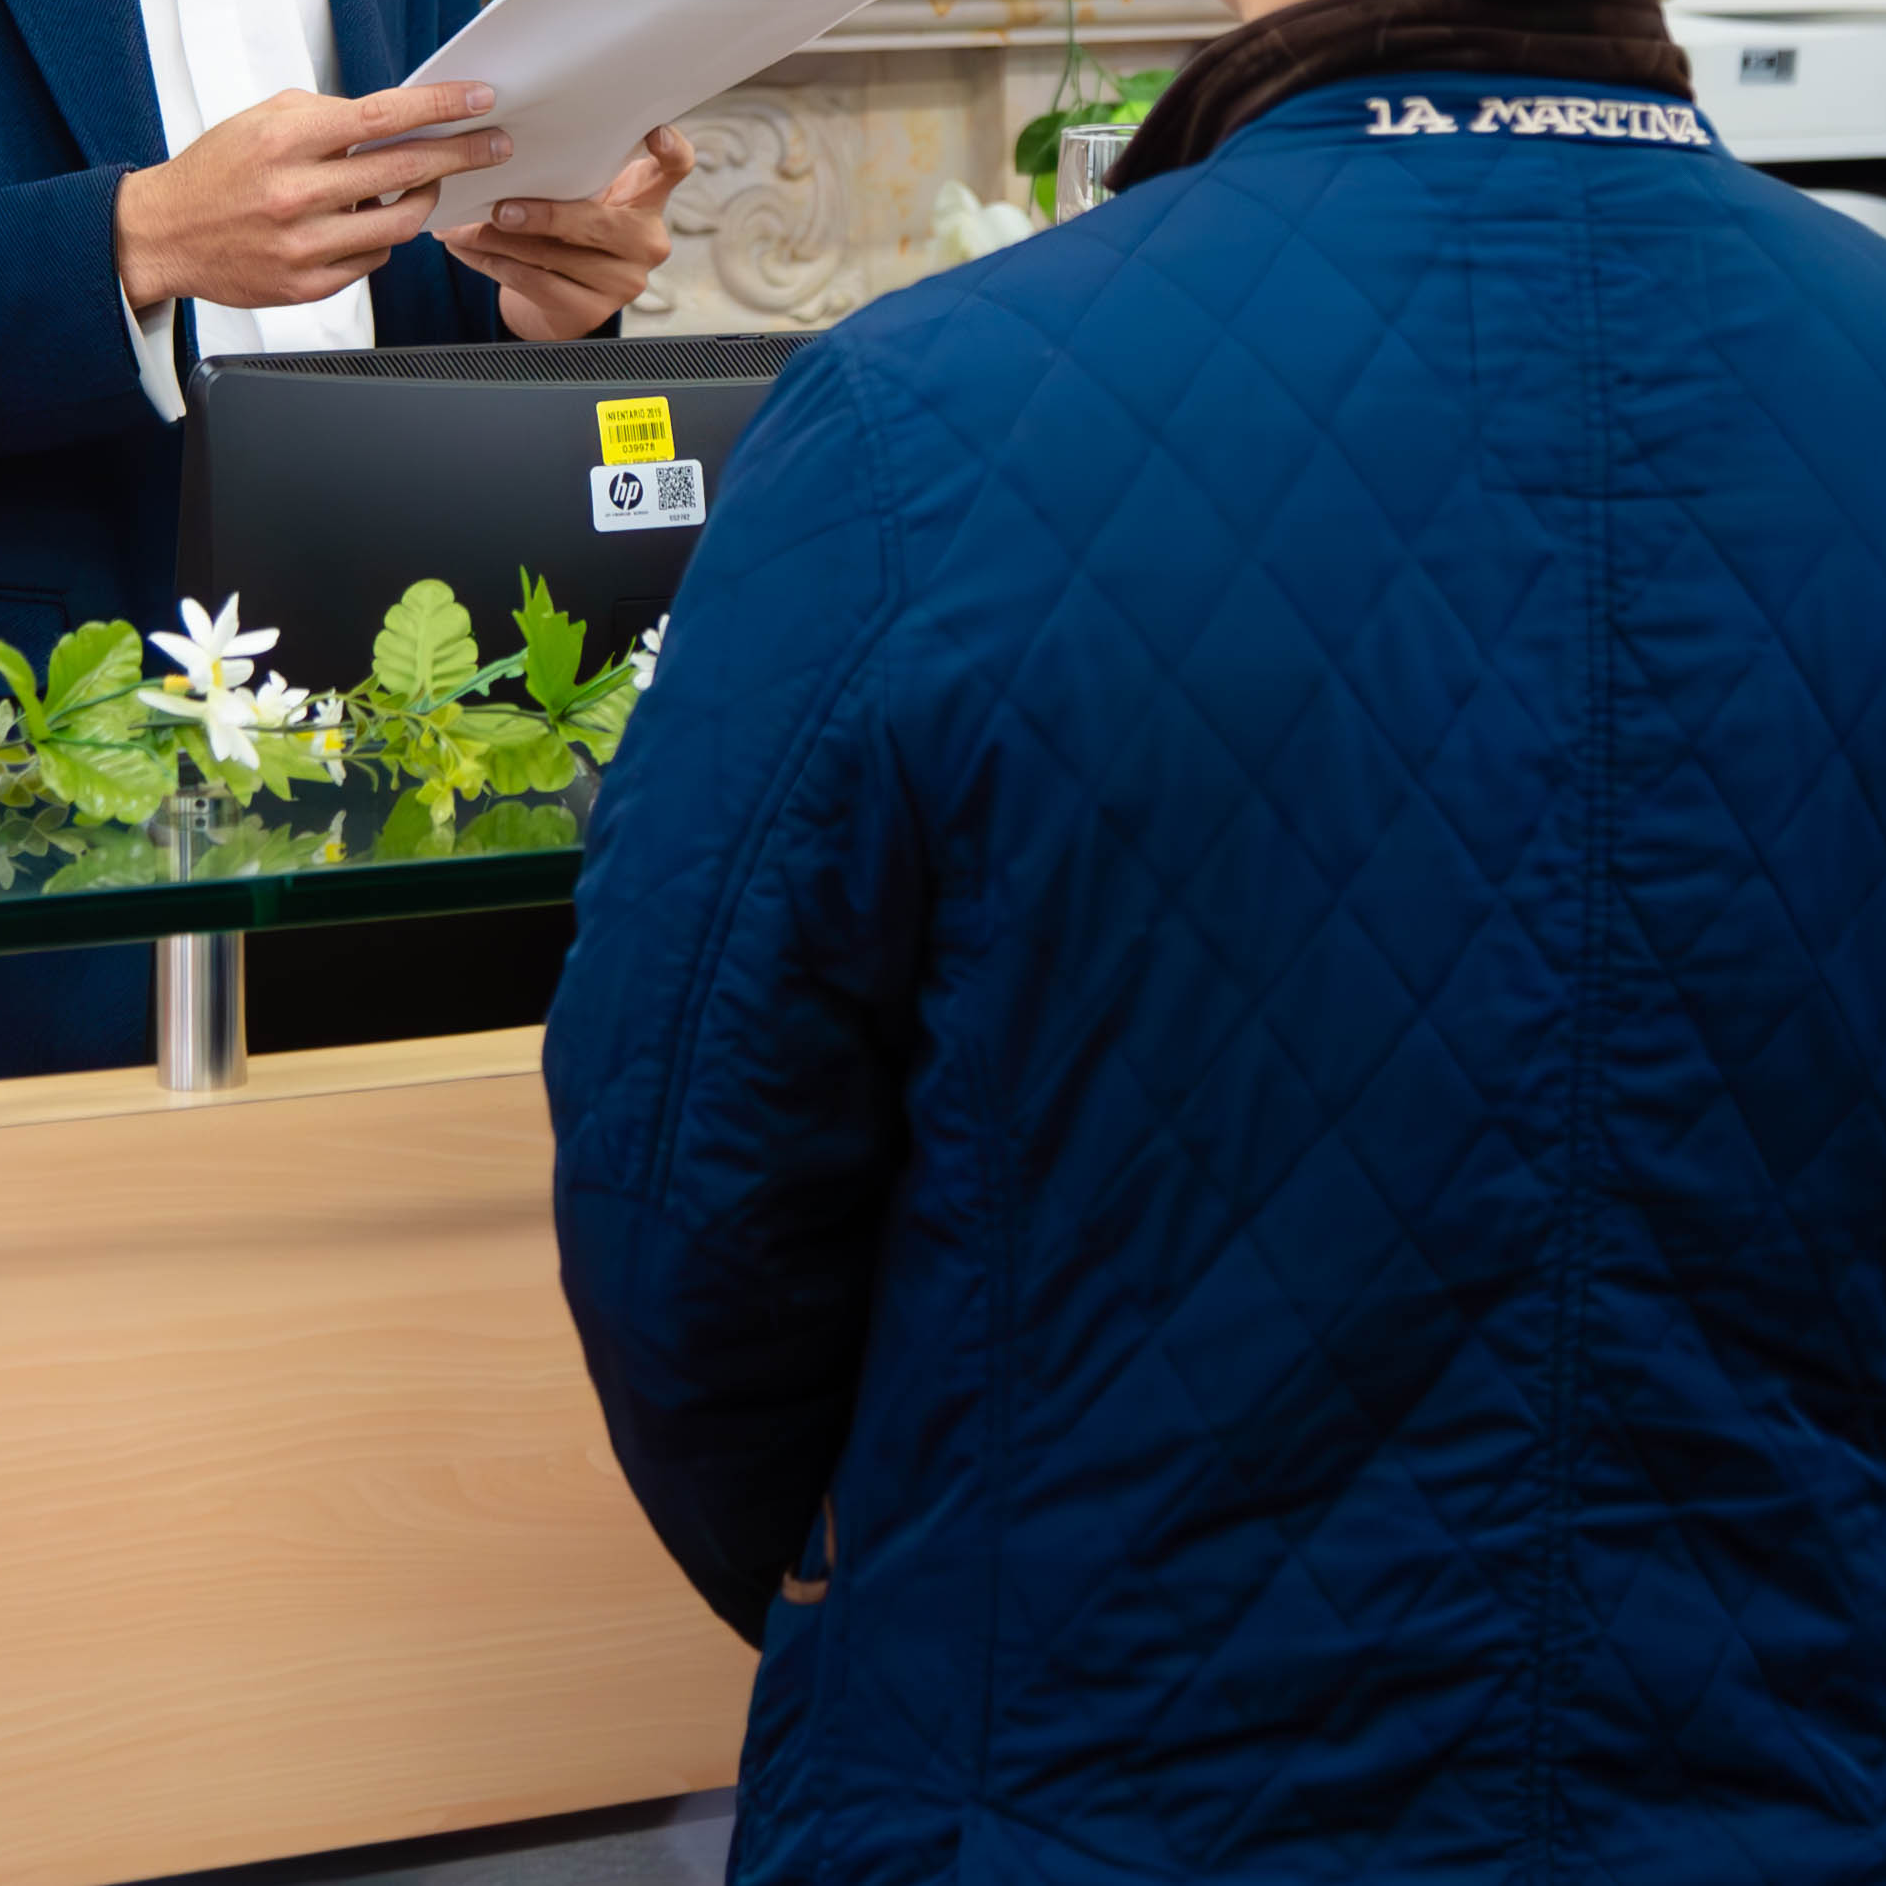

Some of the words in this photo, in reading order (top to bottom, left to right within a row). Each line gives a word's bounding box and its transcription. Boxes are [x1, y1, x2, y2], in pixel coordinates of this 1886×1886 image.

[1468, 95, 1711, 146] MARTINA
[605, 409, 645, 421] INVENTARIO
[612, 471, 641, 510] hp
